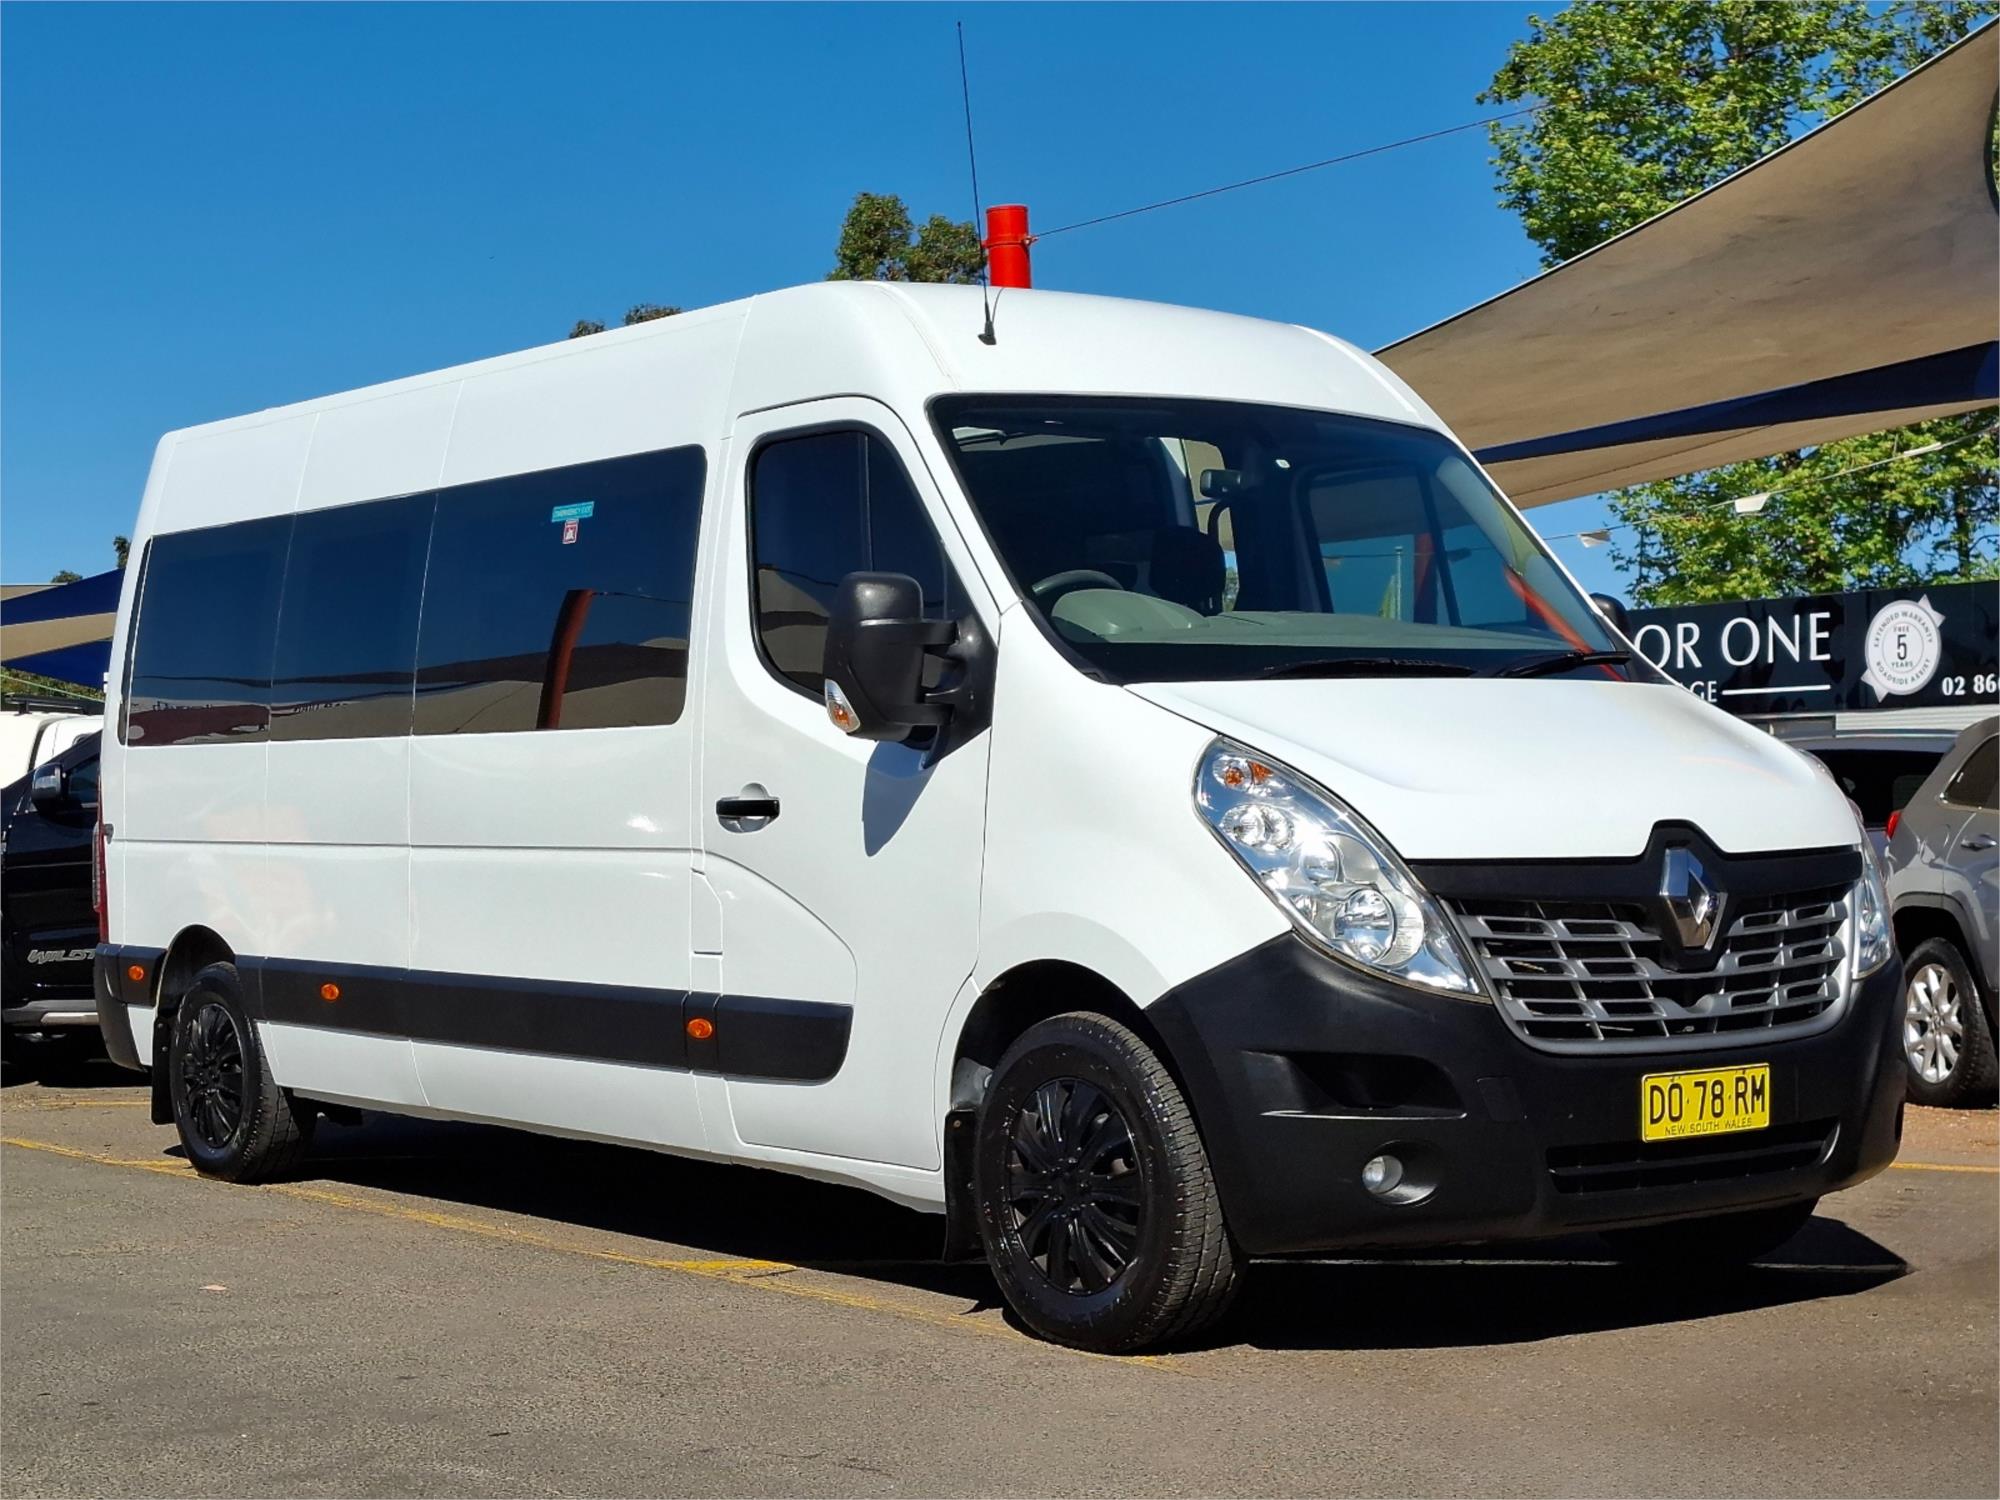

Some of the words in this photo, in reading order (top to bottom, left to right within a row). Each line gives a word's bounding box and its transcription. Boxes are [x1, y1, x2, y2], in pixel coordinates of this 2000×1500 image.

[1721, 611, 1832, 668] ONE
[1874, 612, 1899, 647] EXTENDED
[1901, 611, 1932, 643] WARRANTY
[1896, 634, 1908, 660] 5
[1876, 660, 1909, 686] ROADSIDE
[1910, 658, 1931, 682] ASSIST
[1941, 676, 1966, 696] 02
[1973, 673, 1999, 694] 86
[1681, 680, 1718, 703] GE
[1649, 1083, 1683, 1125] DO
[1693, 1079, 1725, 1121] 78
[1734, 1074, 1766, 1116] RM
[1665, 1123, 1686, 1136] NEW
[1689, 1120, 1720, 1133] SOUTH
[1724, 1117, 1753, 1129] WALES
